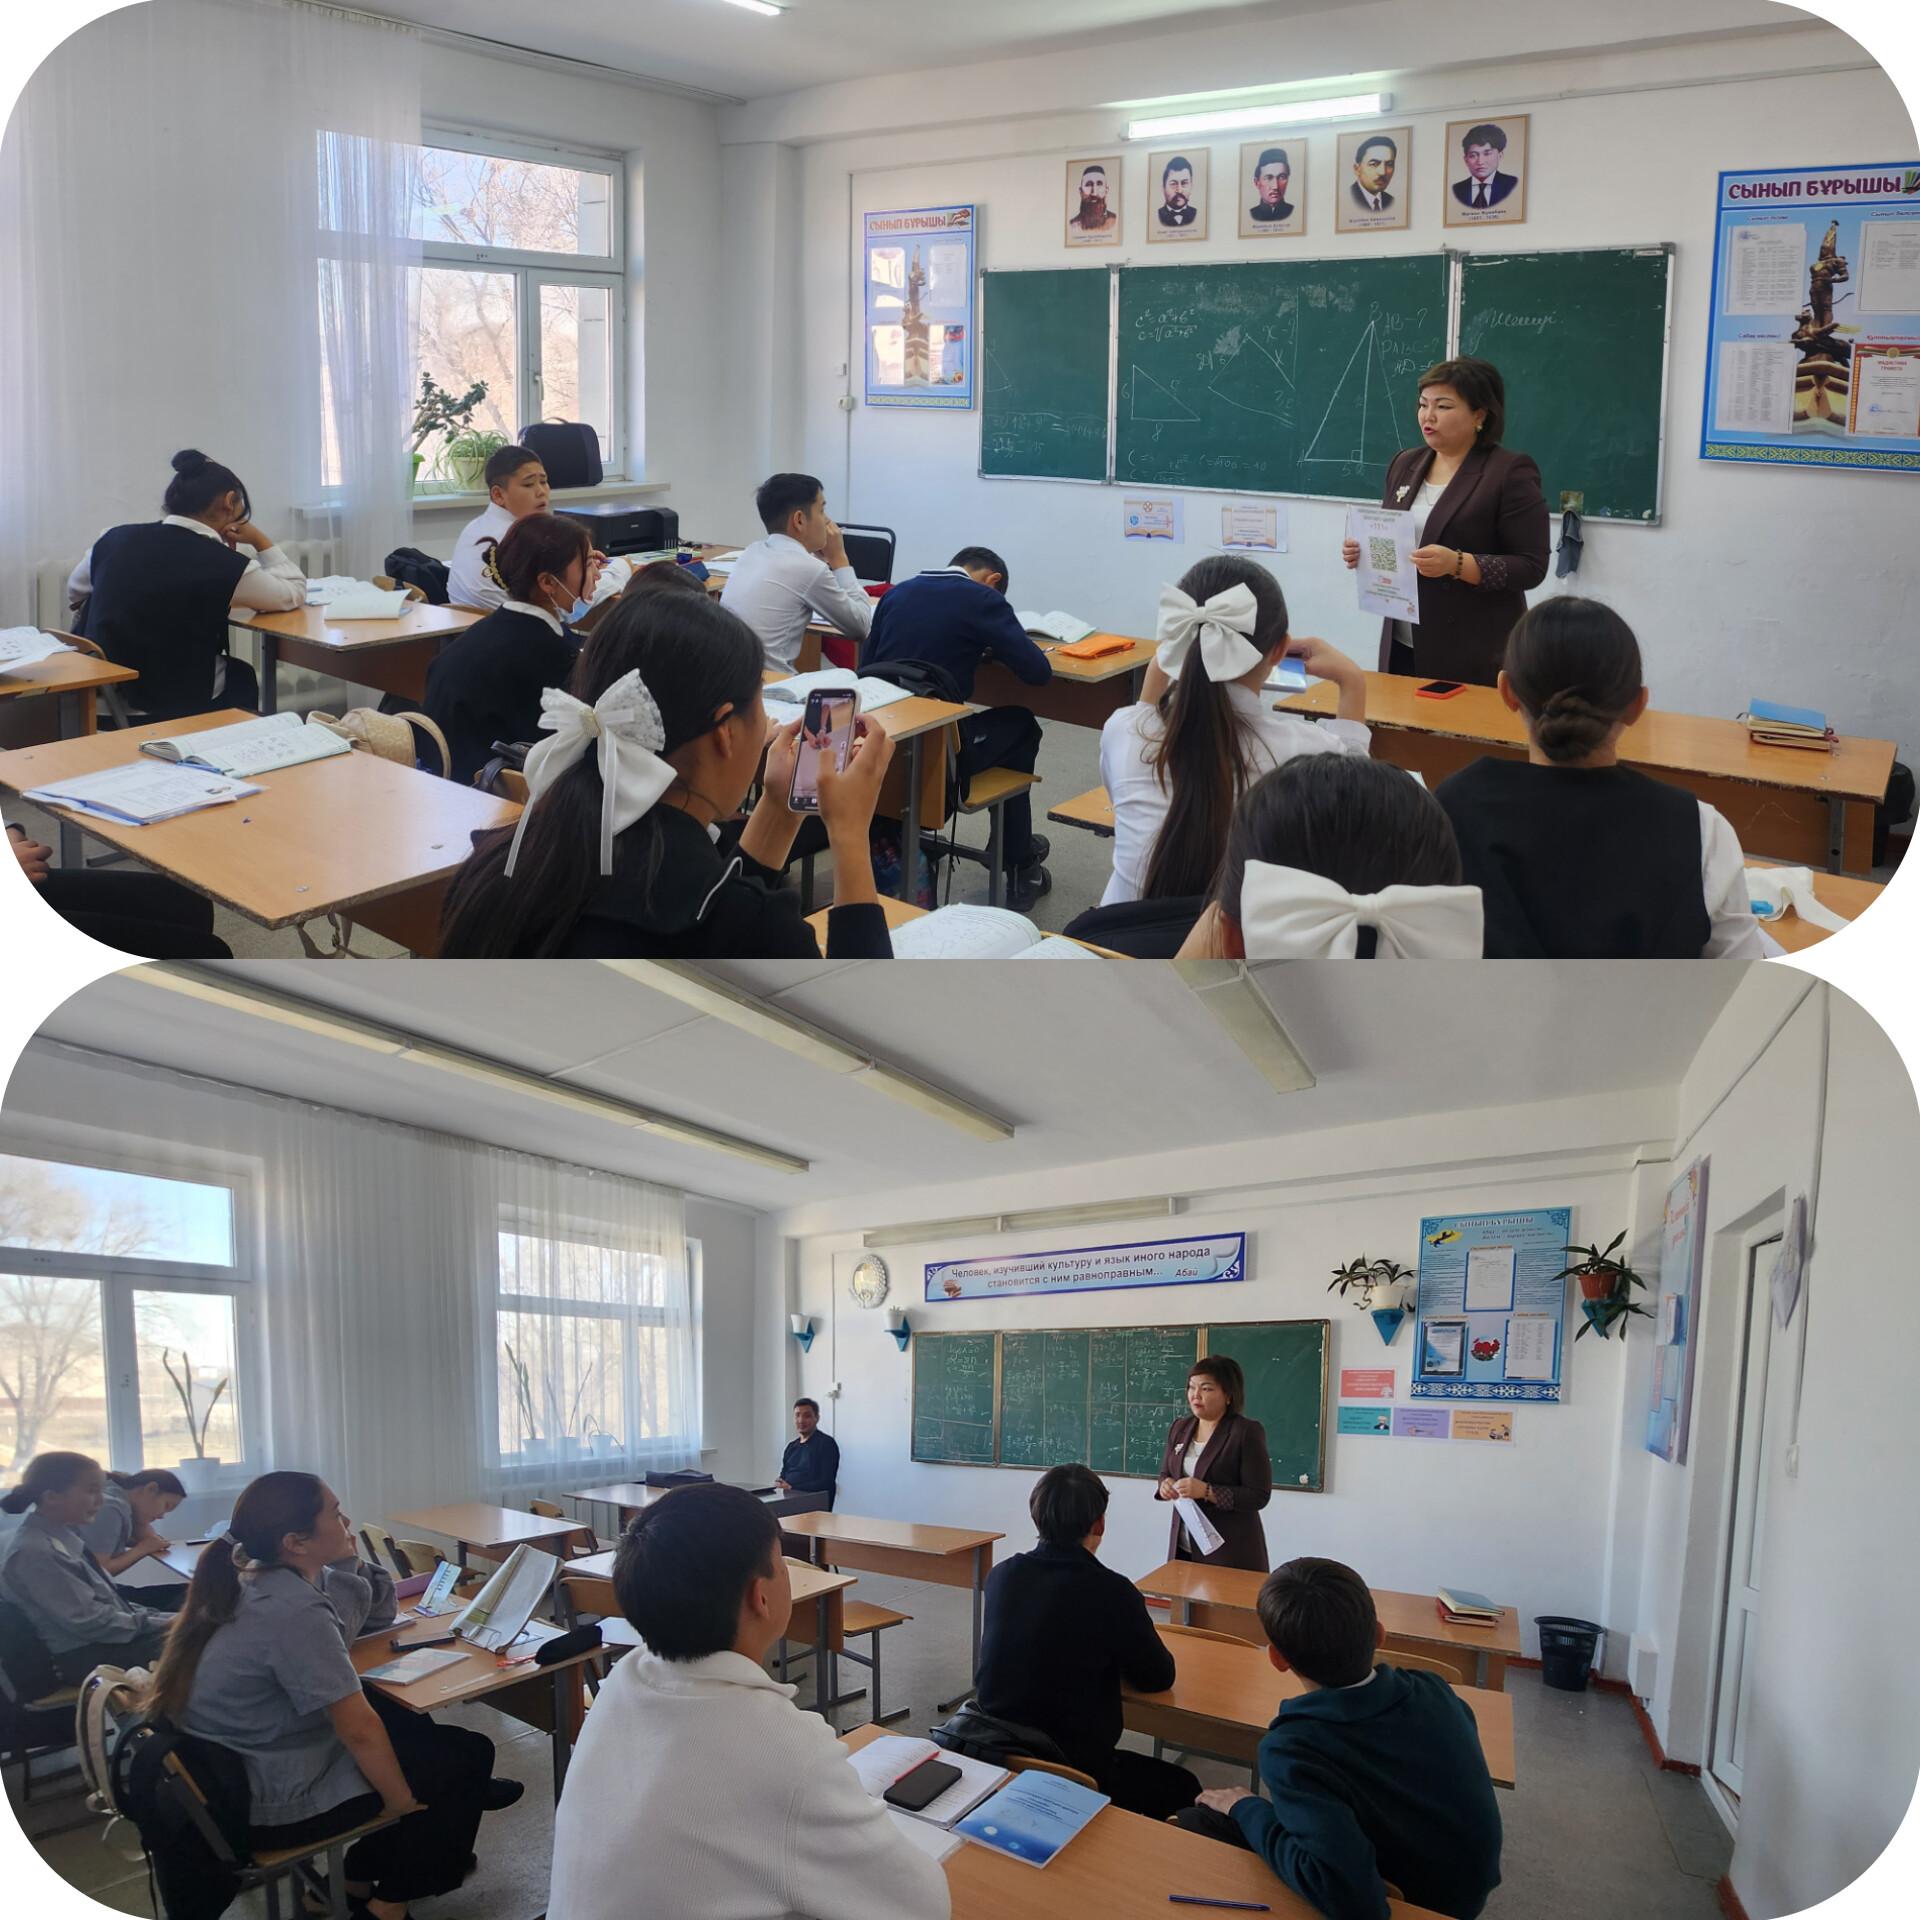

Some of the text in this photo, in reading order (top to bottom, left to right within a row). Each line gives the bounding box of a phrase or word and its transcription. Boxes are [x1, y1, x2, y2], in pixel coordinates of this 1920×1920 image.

[1728, 176, 1901, 200] СЫНЫП БҰРЫШЫ
[952, 1247, 1211, 1279] Человек, изучивший культуру и язык иного народа
[987, 1267, 1163, 1288] становится с ним равноправным...
